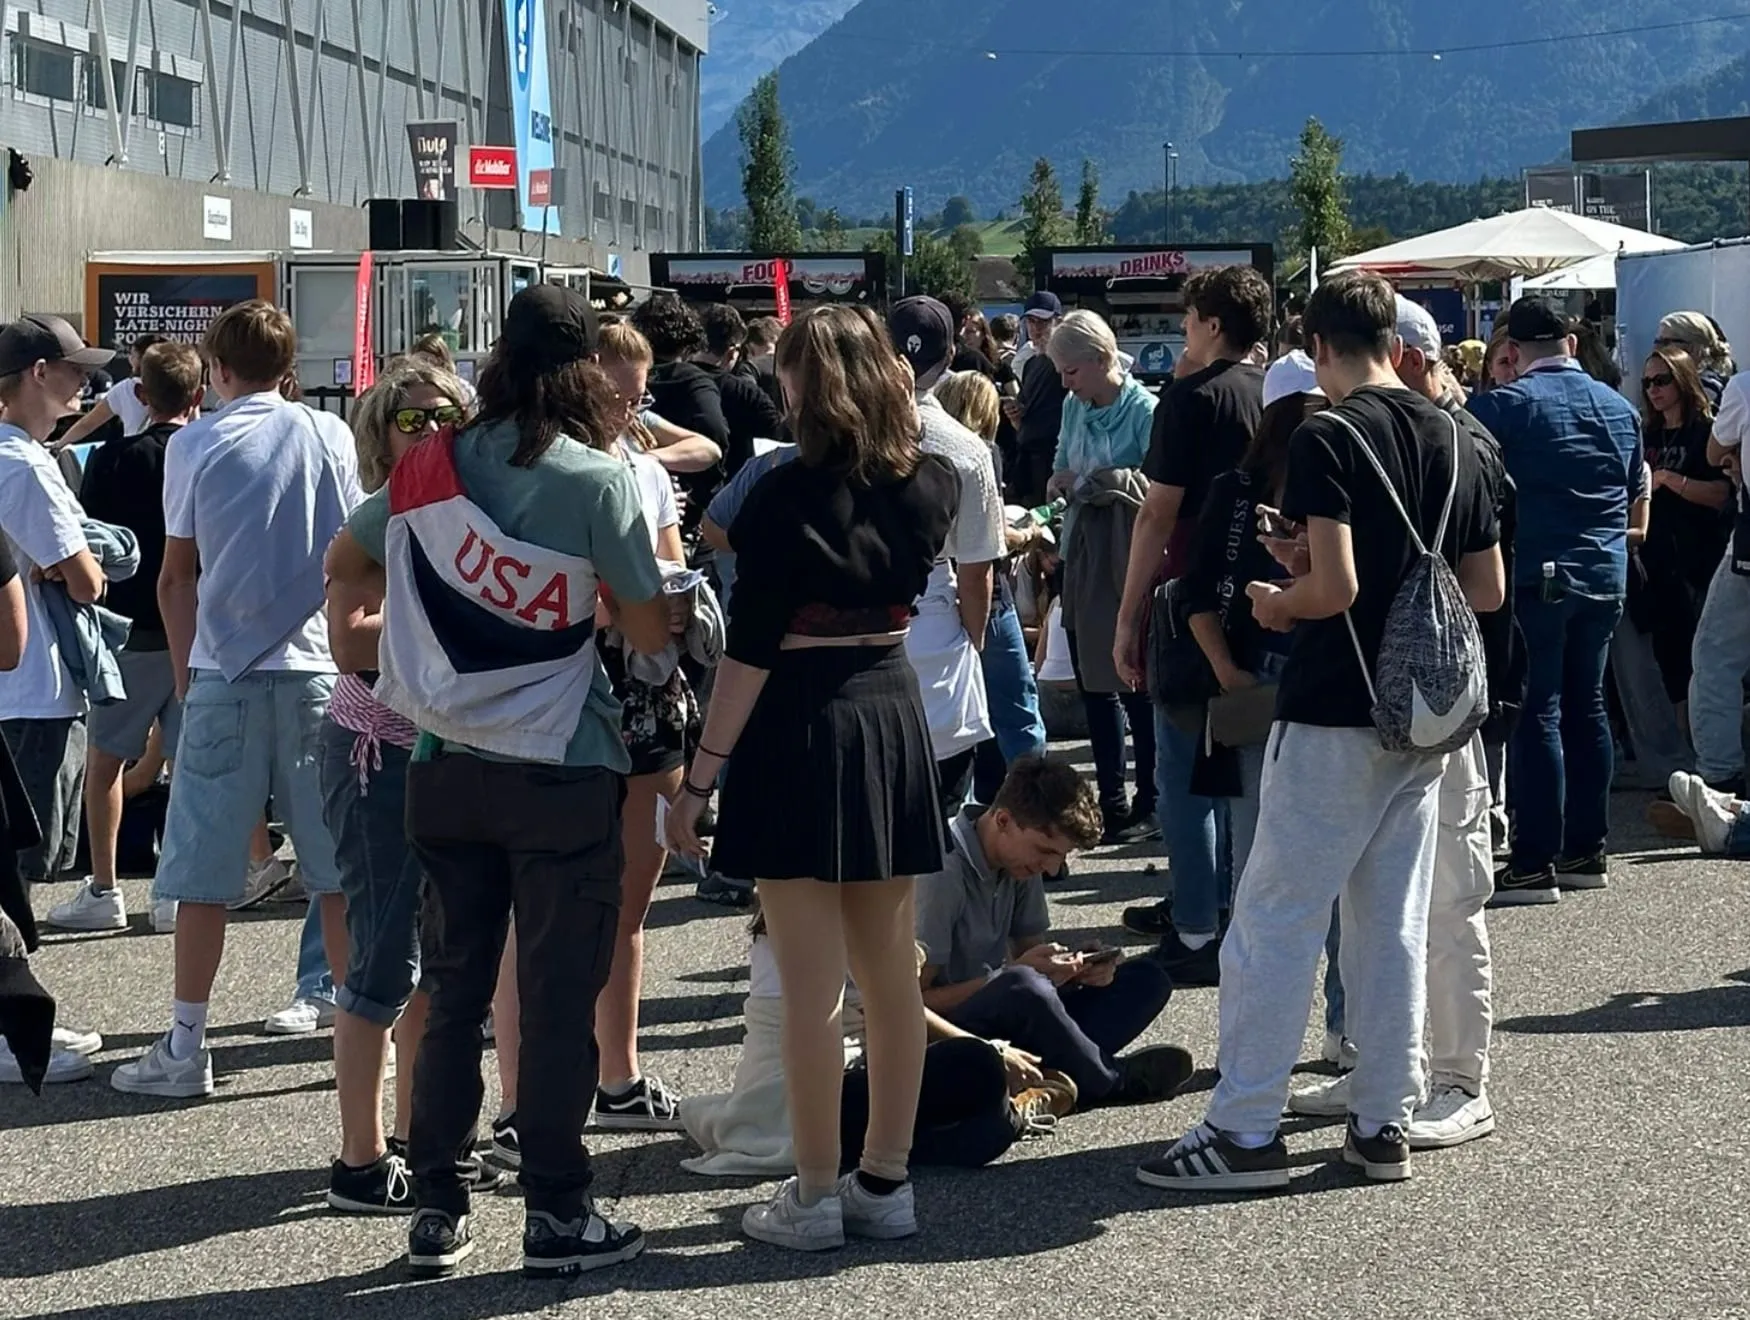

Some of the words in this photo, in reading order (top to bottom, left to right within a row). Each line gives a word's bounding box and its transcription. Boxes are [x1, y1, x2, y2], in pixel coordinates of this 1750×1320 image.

[1121, 252, 1184, 274] DRINKS
[114, 292, 150, 304] WIR
[114, 306, 222, 318] VERSICHERN
[114, 319, 210, 331] LATE-NIGH
[1226, 499, 1249, 561] GUESS
[455, 522, 570, 631] USA
